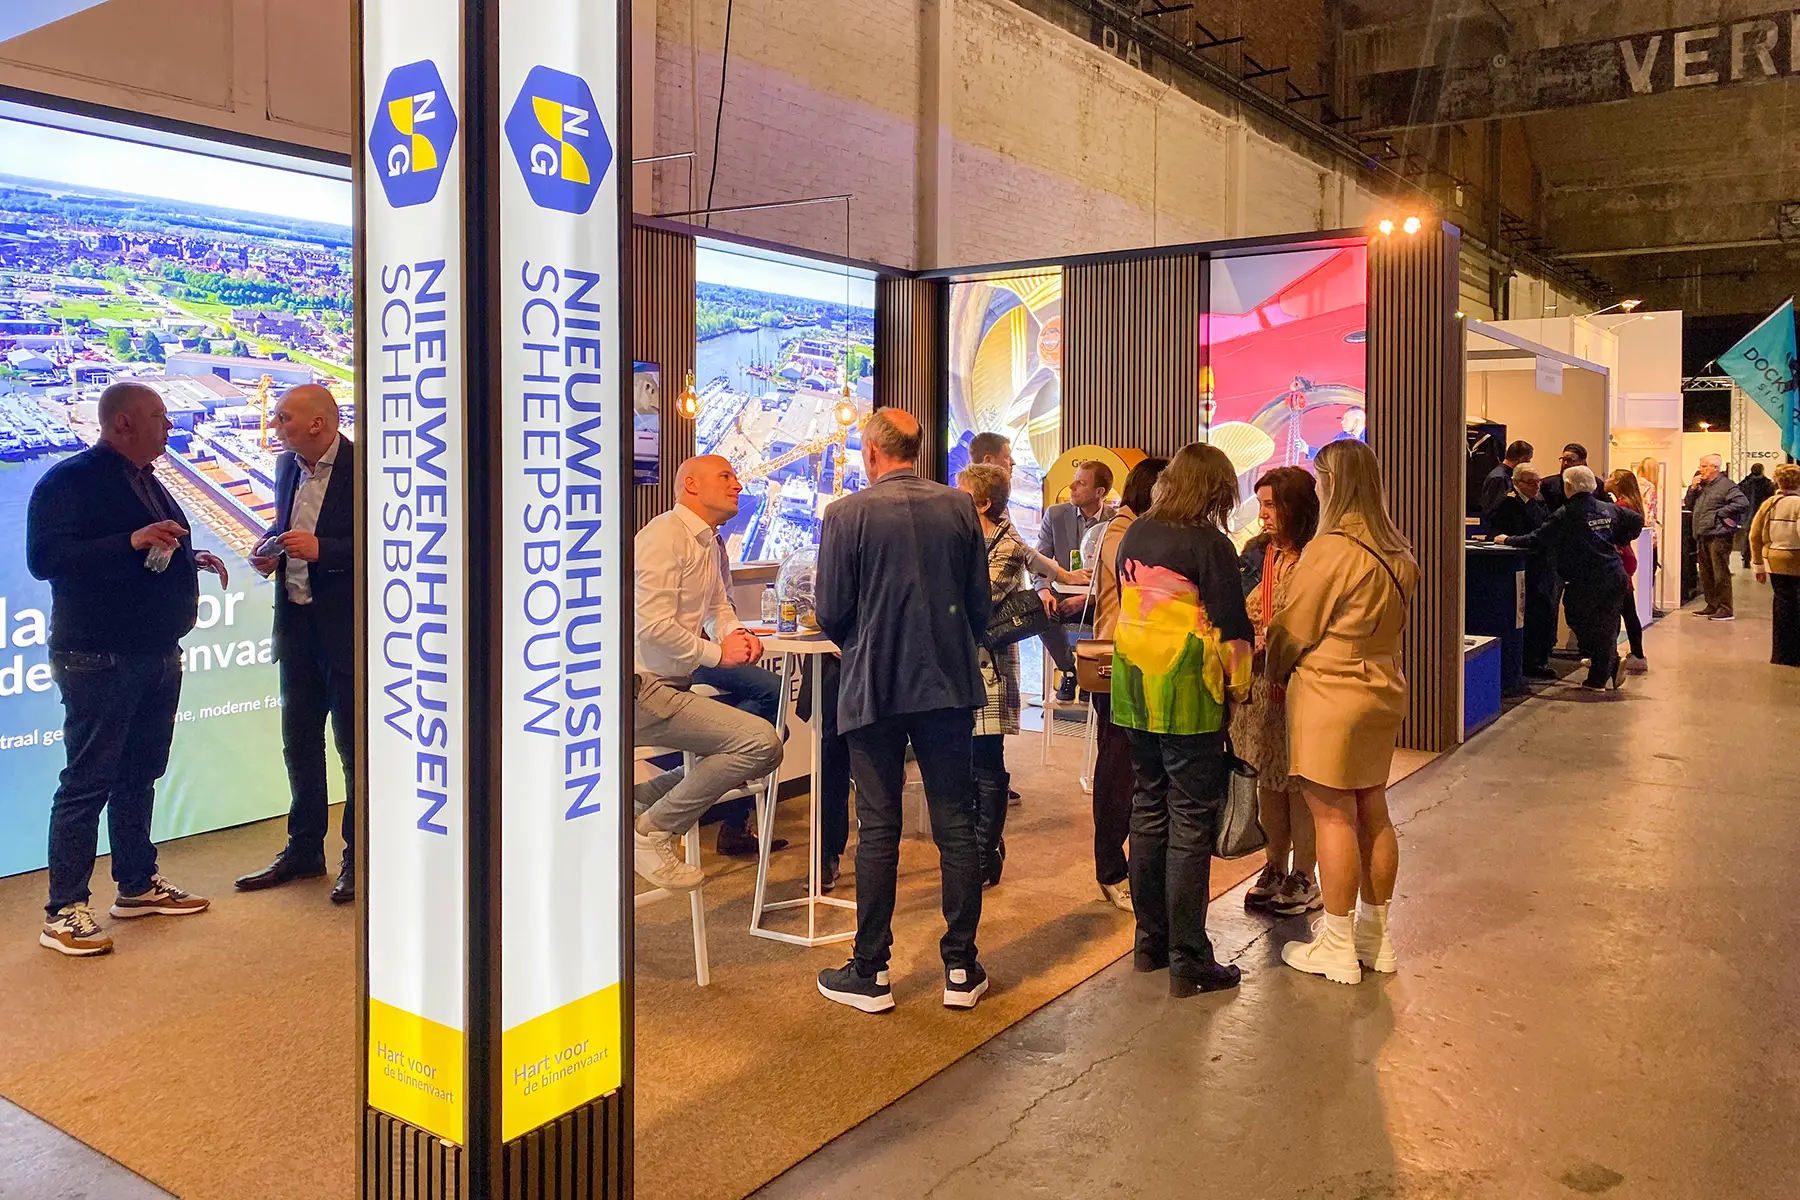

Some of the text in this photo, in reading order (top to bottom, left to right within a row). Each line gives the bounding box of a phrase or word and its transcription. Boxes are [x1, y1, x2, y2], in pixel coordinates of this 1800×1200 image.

[1619, 12, 1800, 93] VER
[1741, 451, 1779, 459] RESCO
[380, 261, 413, 741] SCHEEPSBOUW
[521, 260, 560, 737] SCHEEPSBOUW
[414, 259, 448, 836] NIEUWENHUIJSEN
[563, 269, 601, 821] NIEUWENHUIJSEN
[0, 591, 244, 649] la or
[180, 638, 273, 673] nvaa
[0, 729, 38, 750] traal
[43, 729, 64, 746] ge
[200, 701, 261, 719] moderne
[264, 695, 283, 709] fac
[377, 1040, 437, 1080] Hart voor
[384, 1063, 454, 1105] de binnenvaart
[513, 1038, 589, 1086] Hart voor
[523, 1047, 609, 1097] de binnenvaart
